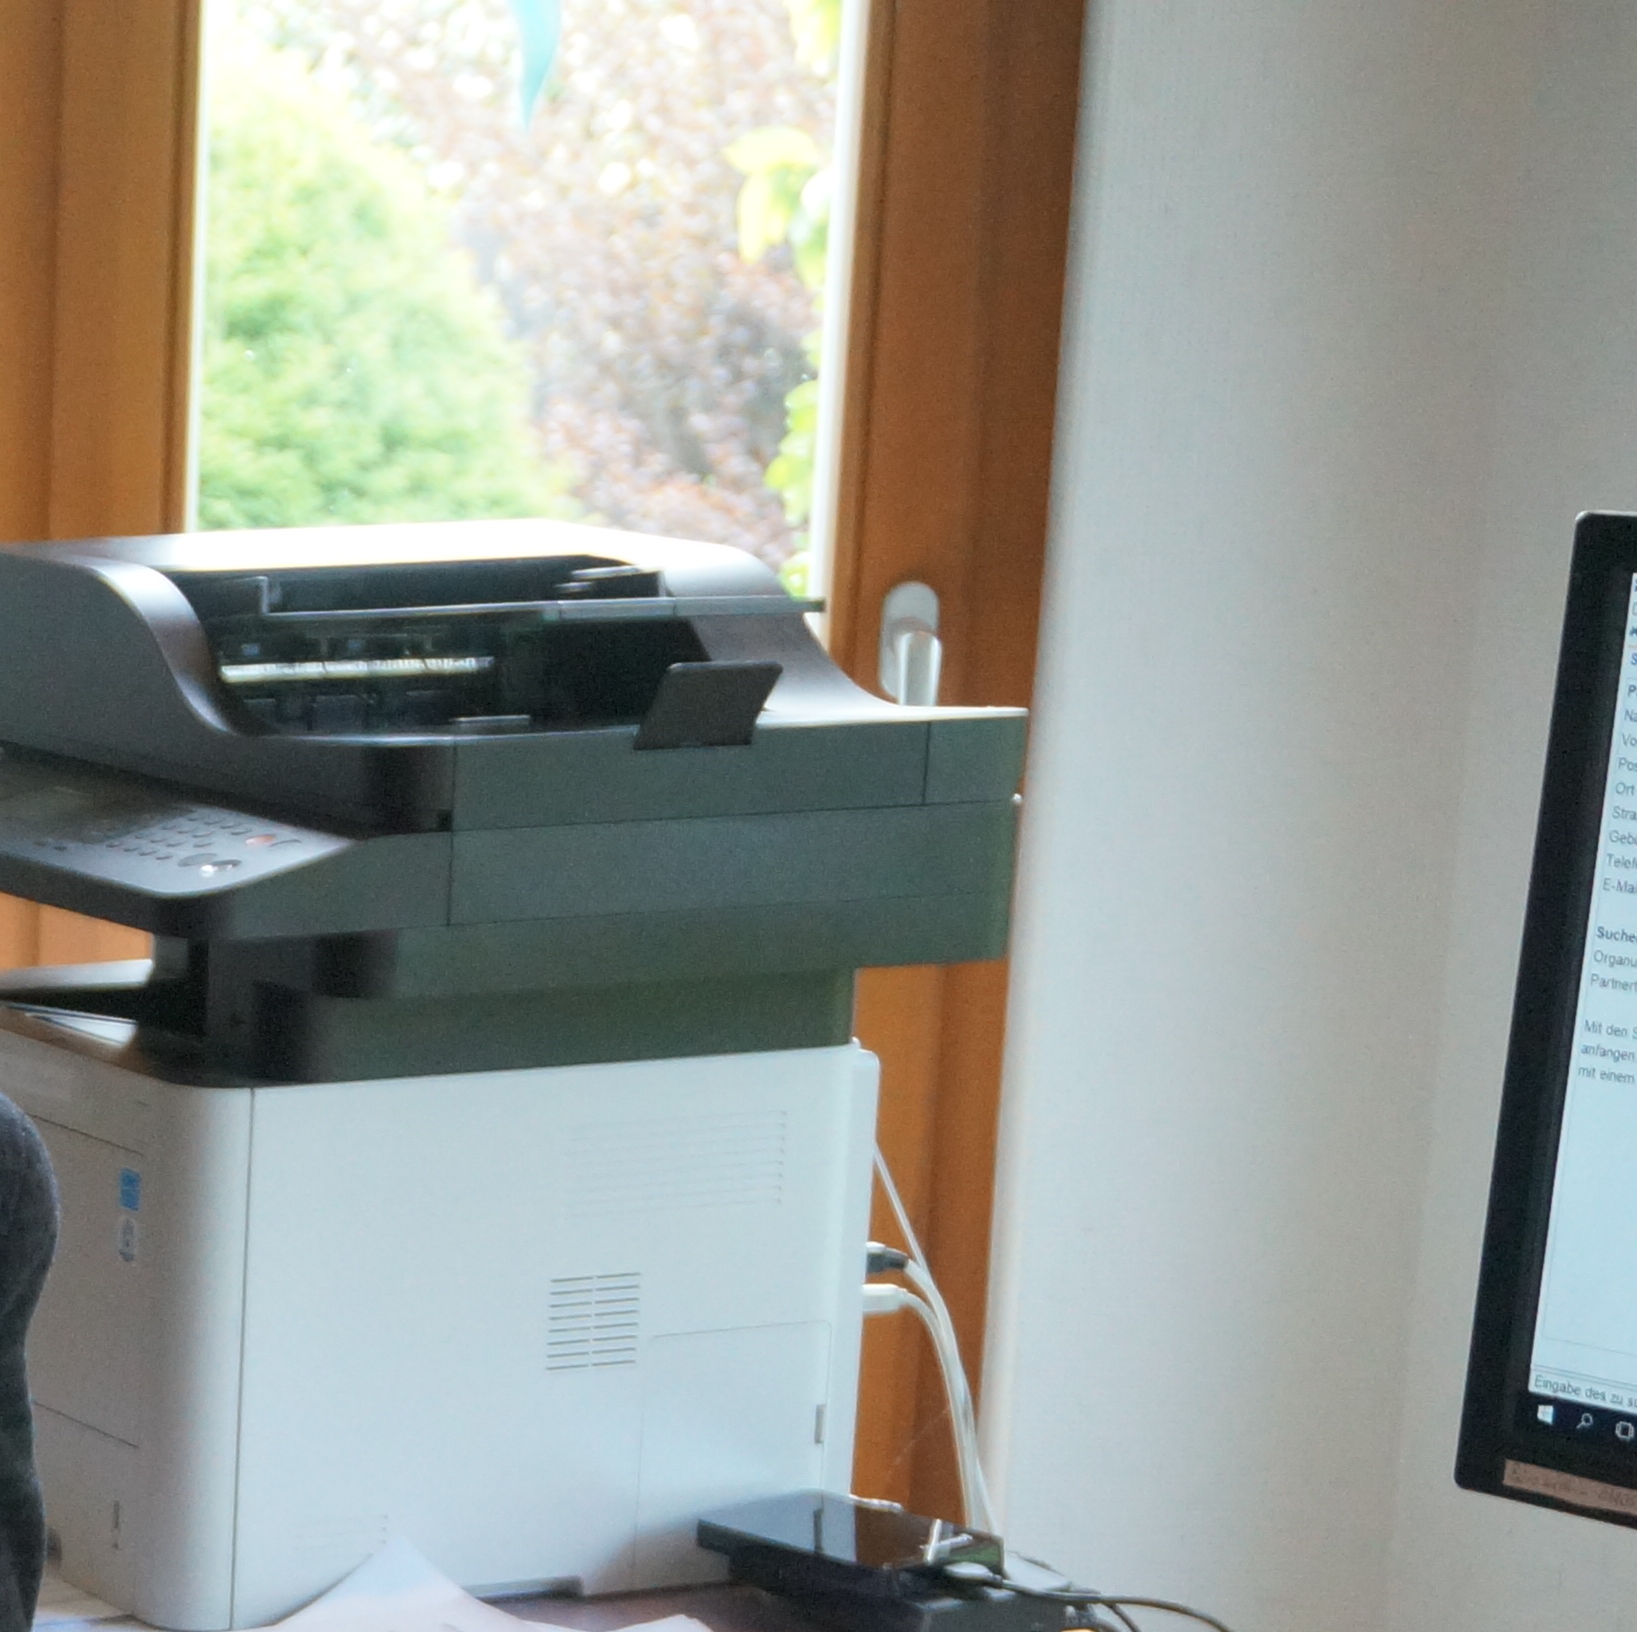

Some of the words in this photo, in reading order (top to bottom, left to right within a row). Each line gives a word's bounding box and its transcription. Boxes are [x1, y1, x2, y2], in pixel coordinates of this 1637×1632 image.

[1615, 781, 1635, 796] Ort
[1606, 853, 1637, 870] Telef
[1584, 1020, 1602, 1035] Mit
[1606, 1024, 1628, 1037] den
[1578, 1065, 1597, 1077] mit
[1600, 1068, 1635, 1083] einem
[1534, 1374, 1581, 1397] Eingabe
[1585, 1387, 1606, 1400] des
[1611, 1394, 1623, 1405] zu
